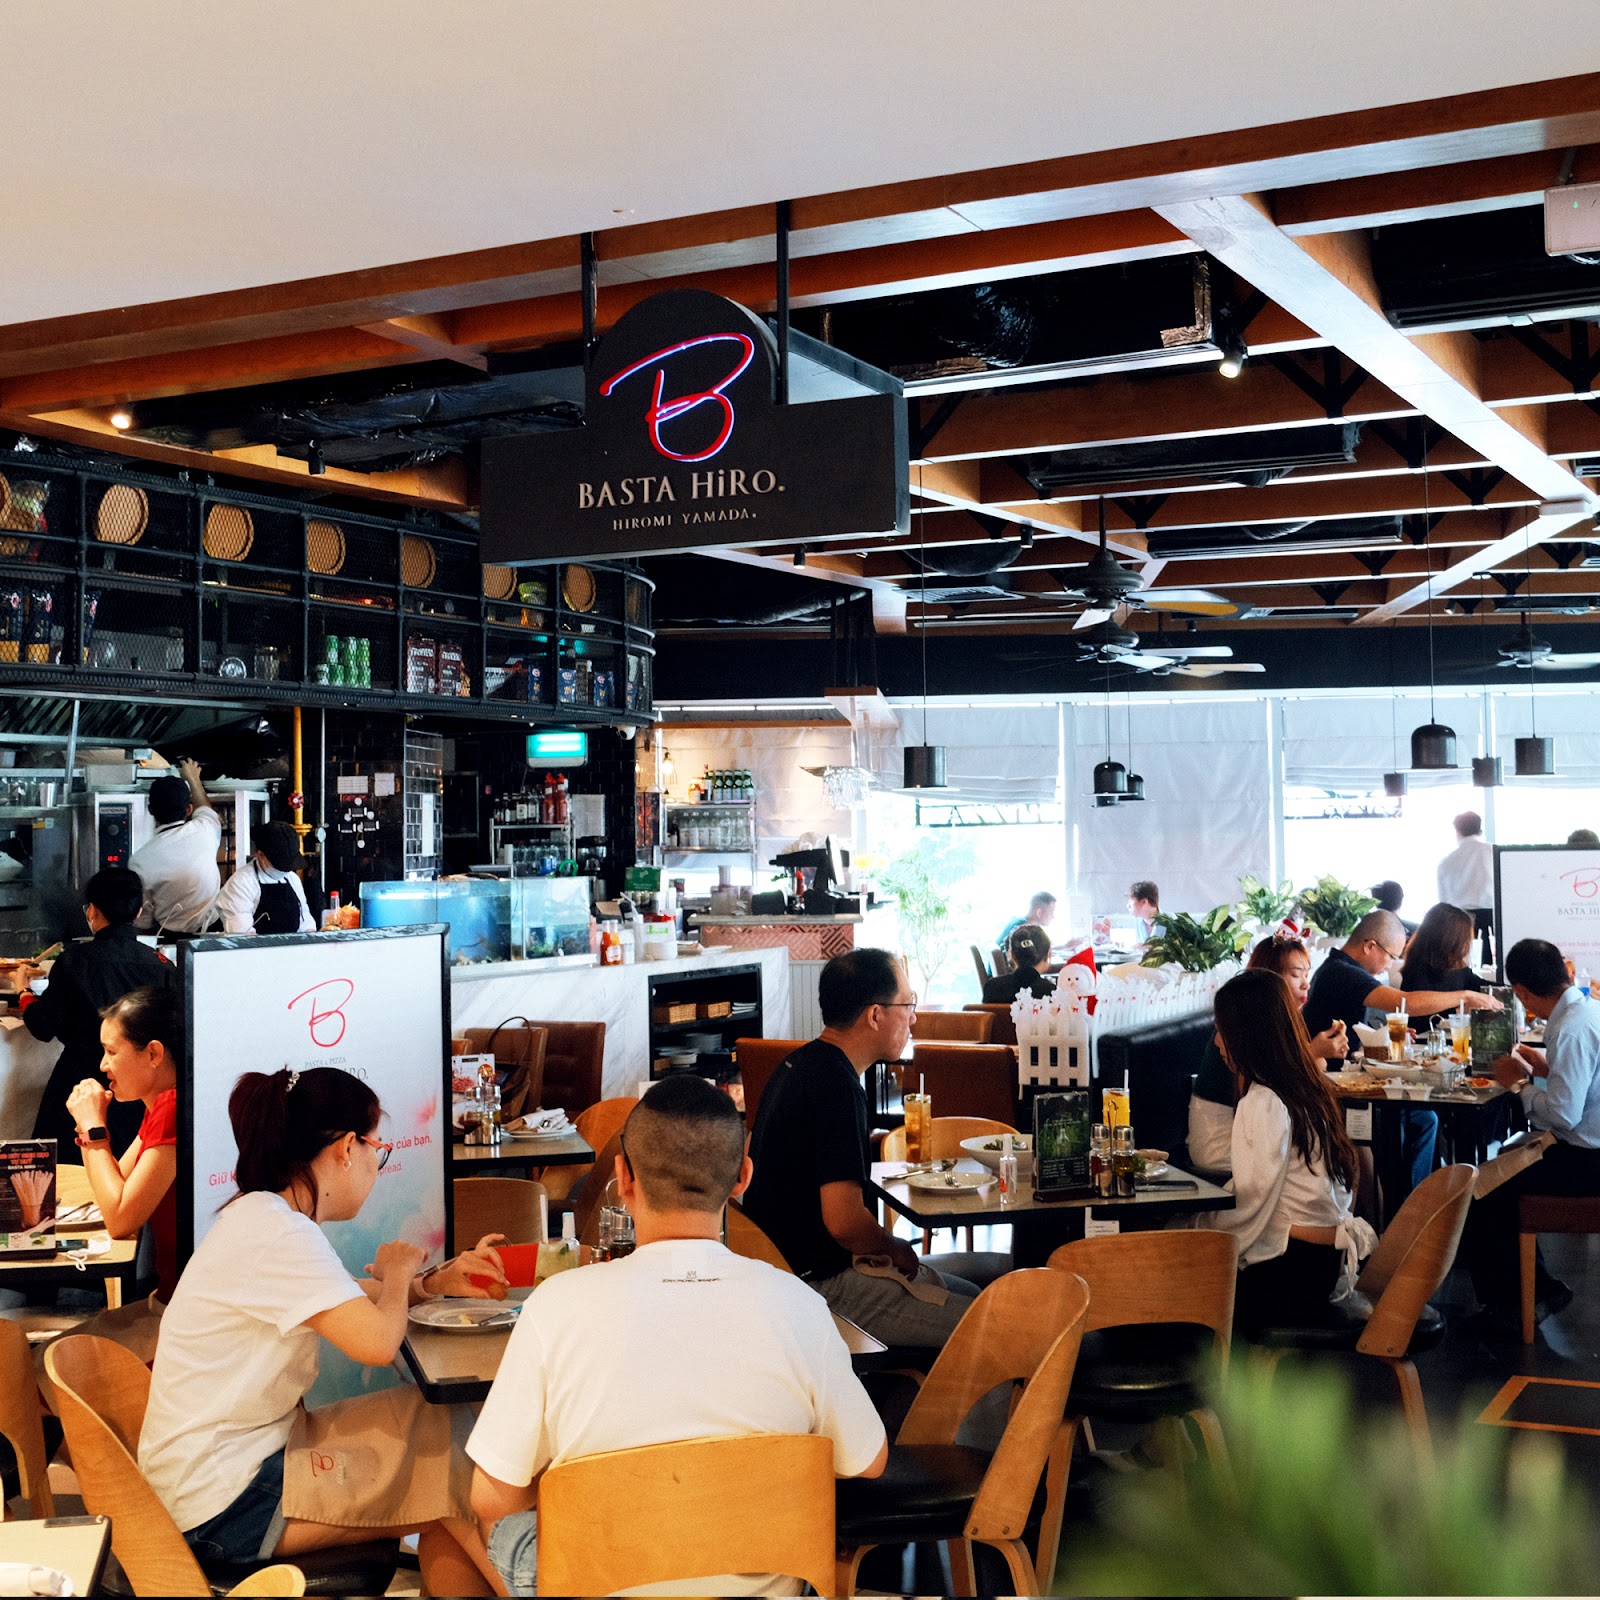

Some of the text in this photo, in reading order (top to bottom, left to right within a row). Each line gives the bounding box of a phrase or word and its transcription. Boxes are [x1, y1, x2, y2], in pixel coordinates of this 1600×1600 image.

[600, 332, 755, 463] B
[578, 475, 677, 510] BASTA
[612, 515, 672, 531] HIROMI
[287, 978, 355, 1047] B
[396, 1136, 412, 1149] của
[378, 1161, 403, 1176] pread.
